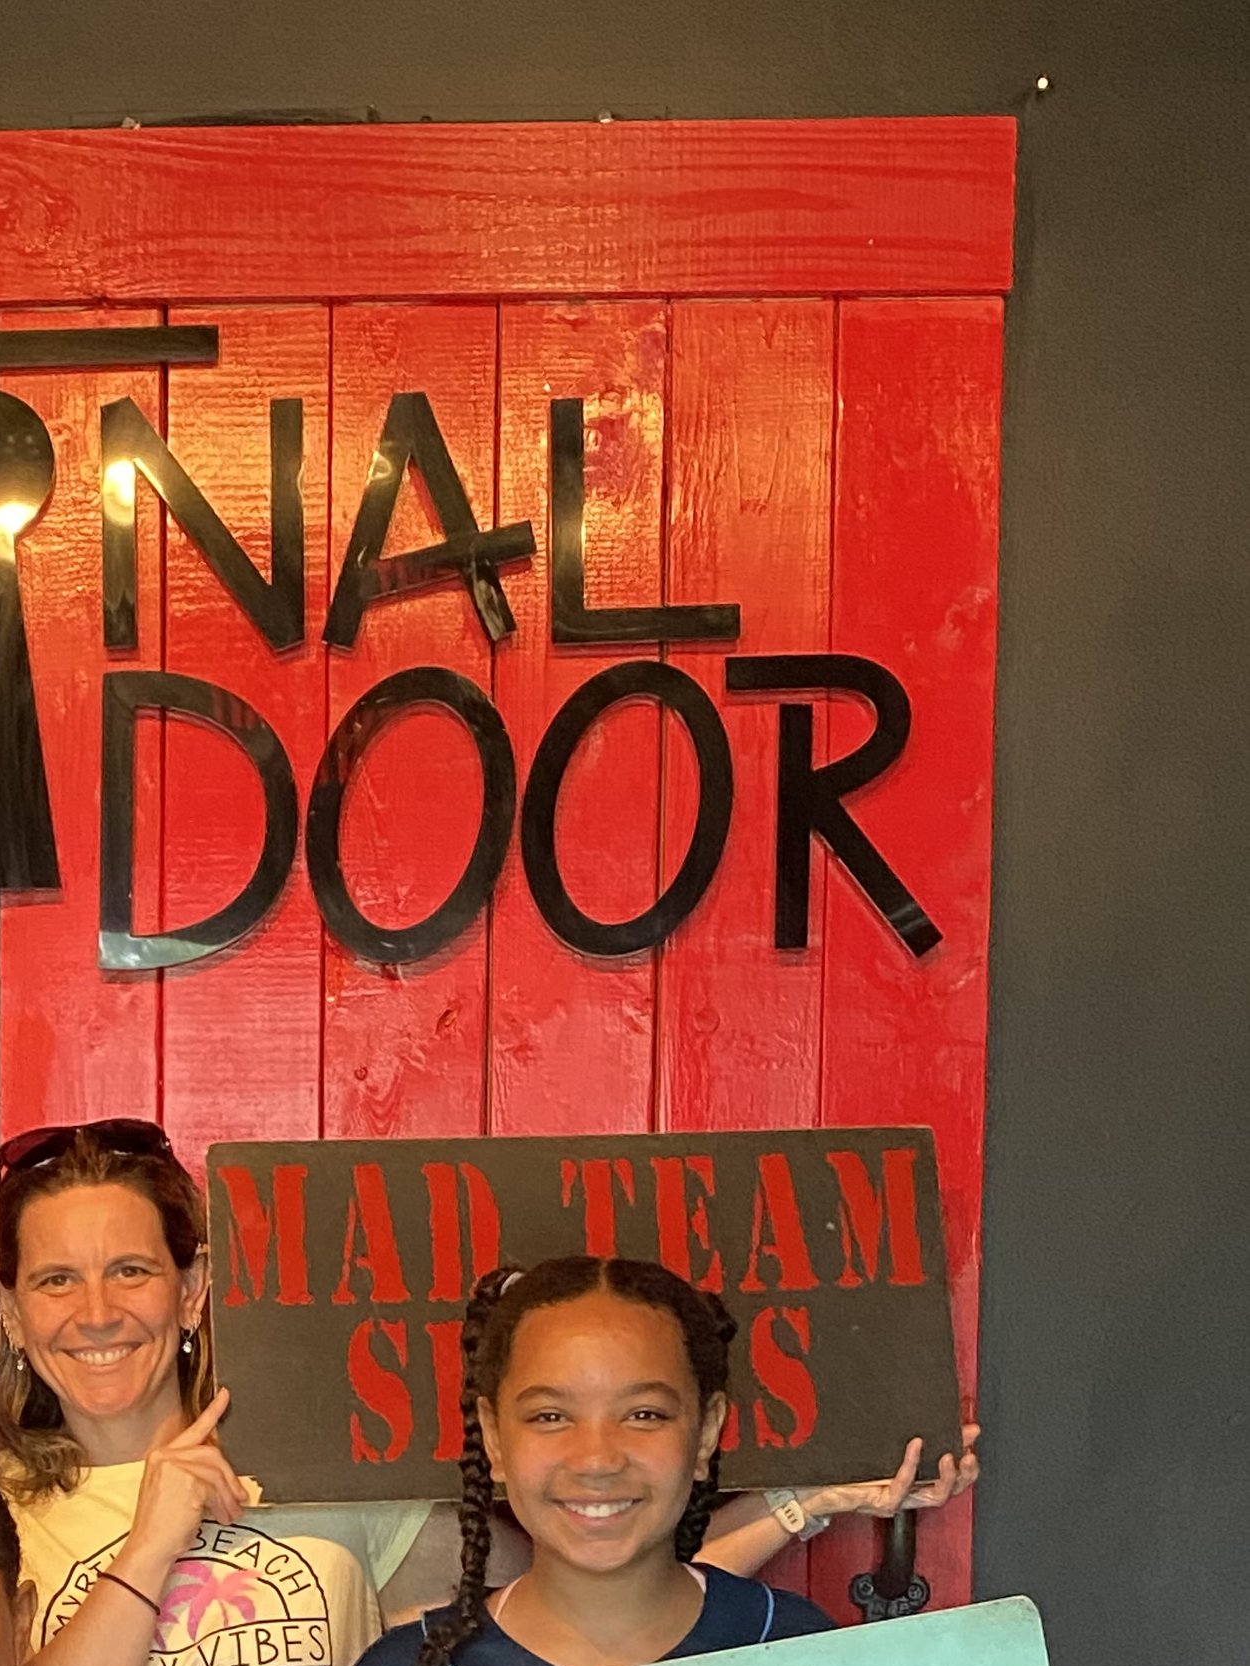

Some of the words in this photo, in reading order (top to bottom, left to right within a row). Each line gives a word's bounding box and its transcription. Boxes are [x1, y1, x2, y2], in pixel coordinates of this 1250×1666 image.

[98, 655, 944, 970] DOOR
[218, 1162, 501, 1307] MAD
[560, 1149, 928, 1294] TEAM
